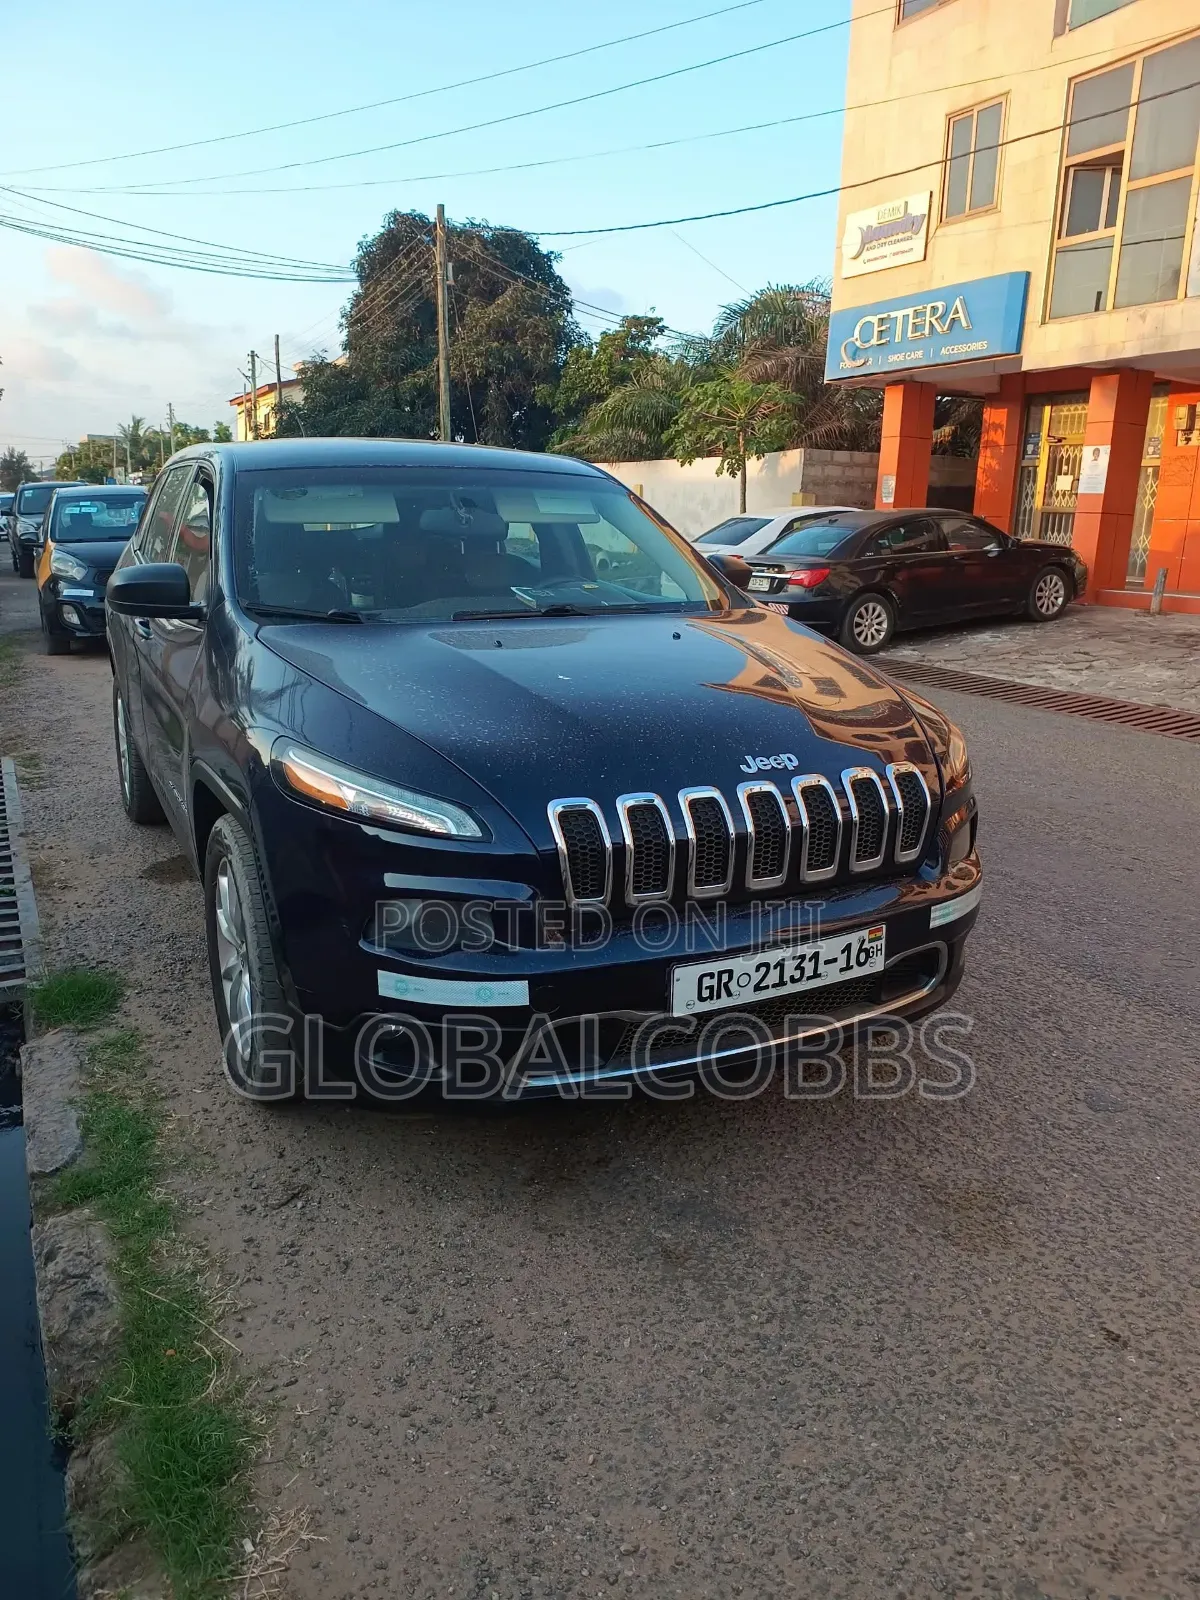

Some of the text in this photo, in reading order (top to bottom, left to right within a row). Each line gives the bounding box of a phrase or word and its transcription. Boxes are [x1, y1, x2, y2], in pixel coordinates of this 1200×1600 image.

[877, 204, 902, 221] DEMIK
[865, 244, 877, 253] AND
[887, 235, 914, 247] CLEANERS
[841, 295, 972, 367] CETERA
[887, 353, 905, 363] SHOE
[905, 350, 924, 361] CARE
[940, 340, 988, 356] ACCESSORIES
[740, 753, 799, 774] Jeep
[868, 942, 883, 959] GH
[697, 938, 869, 1003] GR 2131-16
